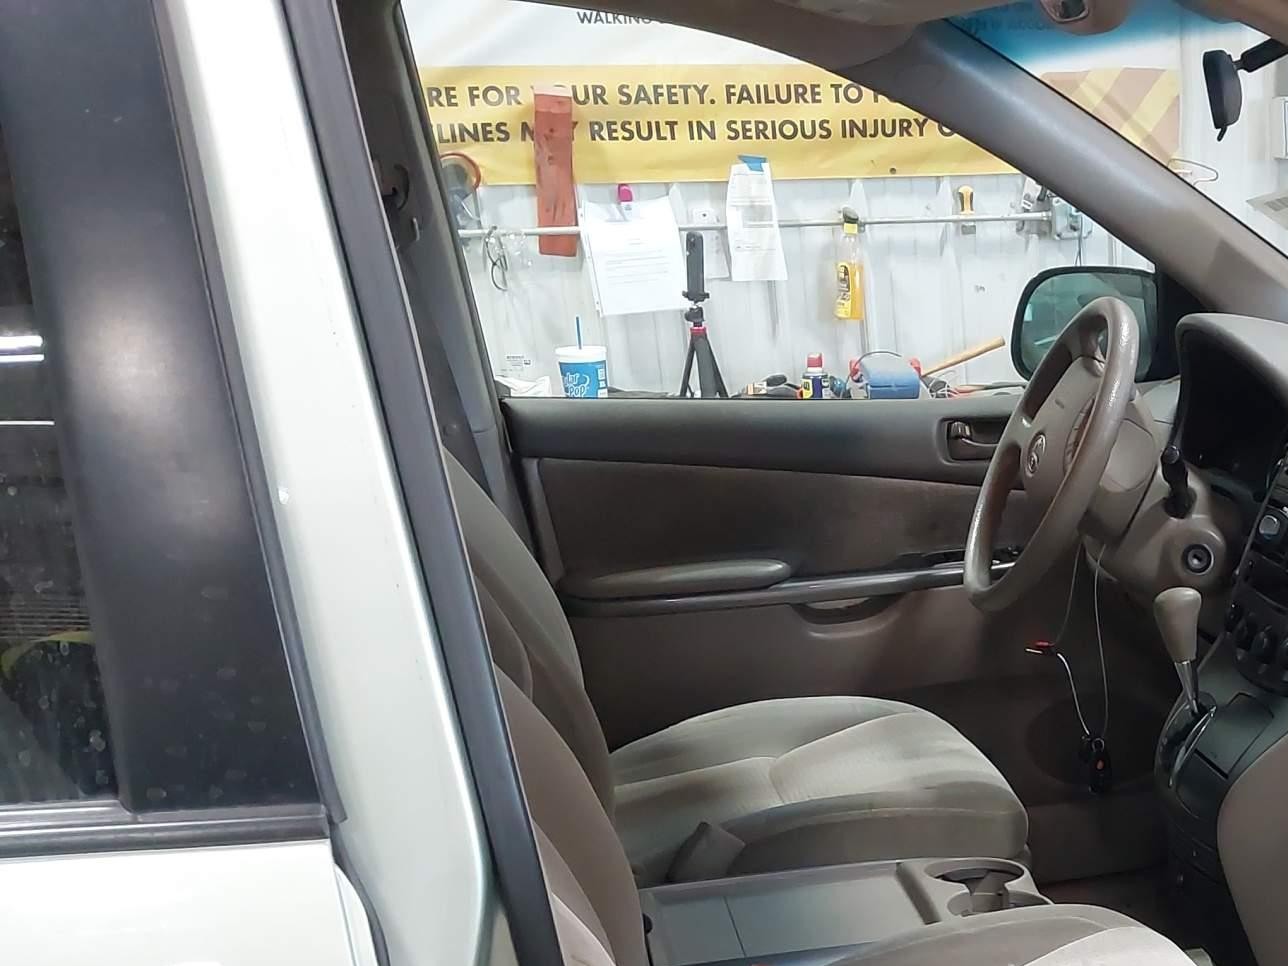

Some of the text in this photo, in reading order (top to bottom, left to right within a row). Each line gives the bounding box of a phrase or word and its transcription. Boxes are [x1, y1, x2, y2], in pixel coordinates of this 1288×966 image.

[427, 86, 459, 107] RE
[468, 86, 522, 107] FOR
[618, 83, 716, 106] SAFETY.
[725, 83, 822, 105] FAILURE
[830, 82, 864, 104] TO
[437, 122, 511, 144] LINES
[589, 120, 679, 142] RESULT
[688, 119, 717, 141] IN
[727, 118, 832, 141] SERIOUS
[841, 118, 929, 138] INJURY
